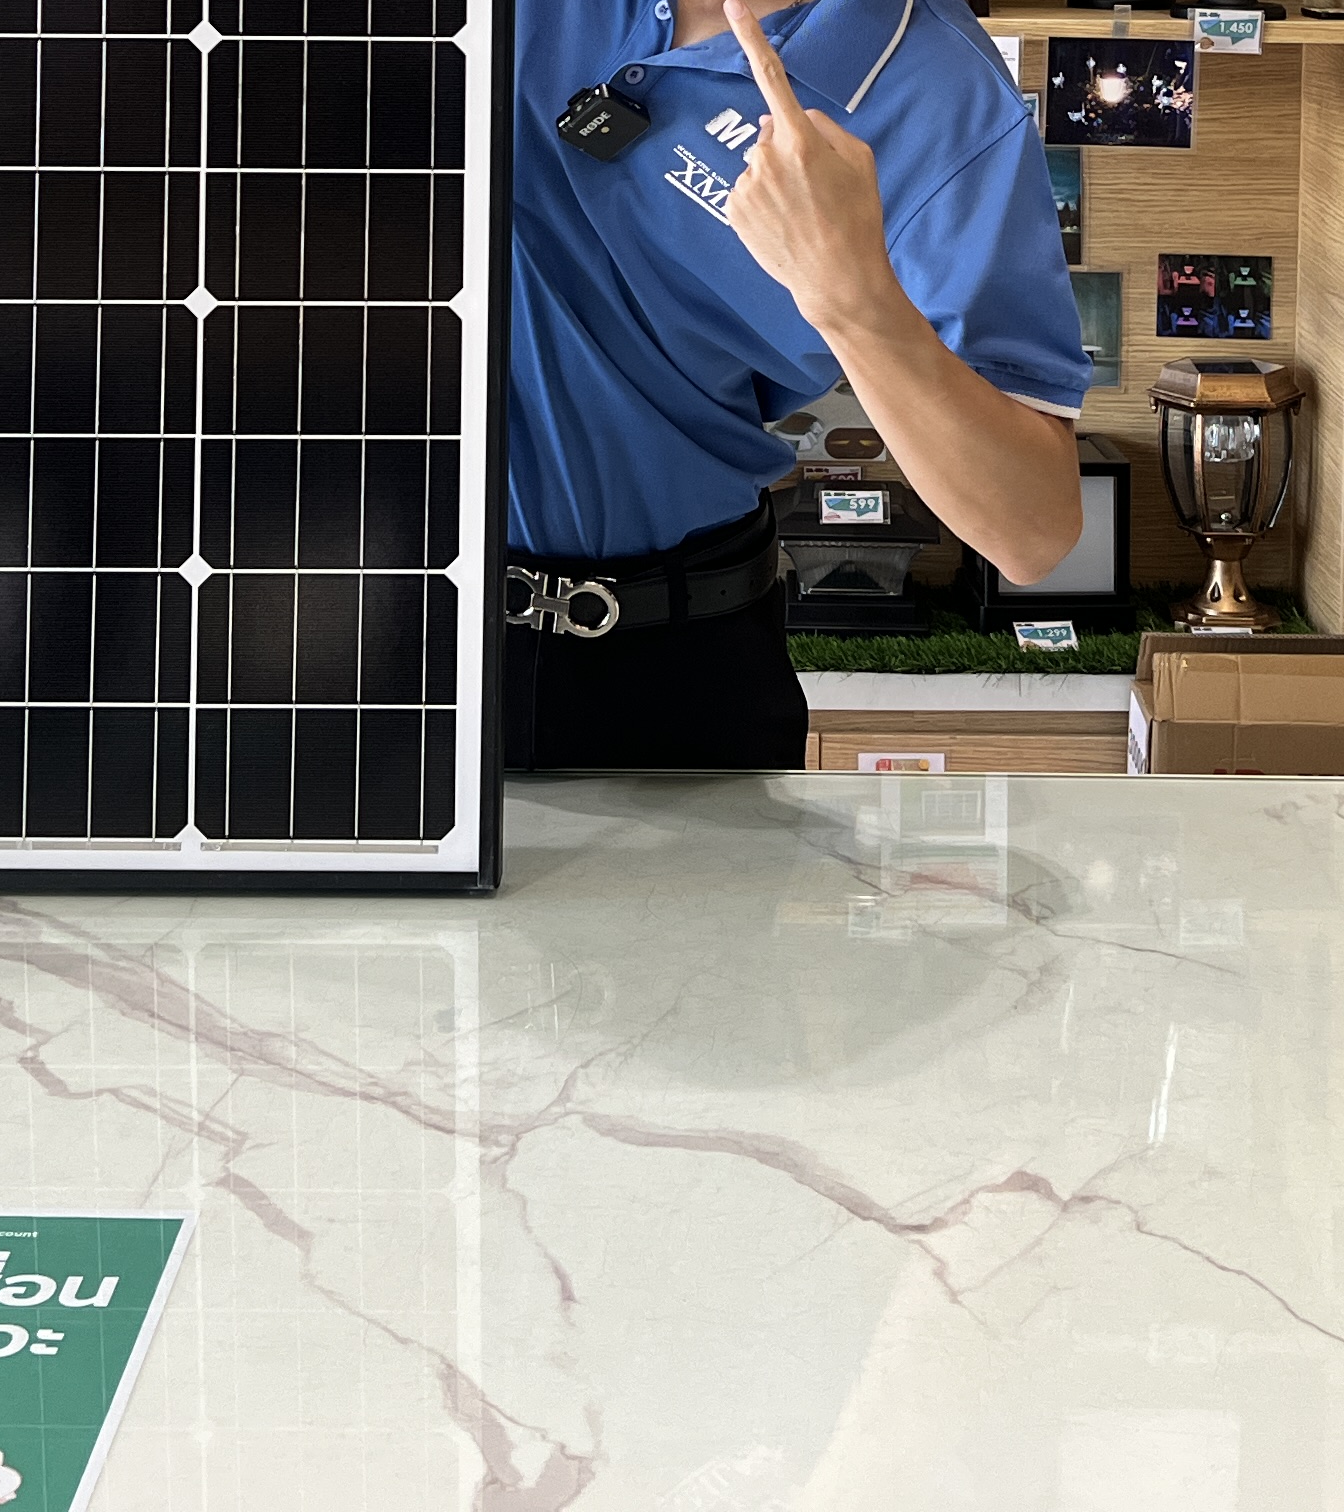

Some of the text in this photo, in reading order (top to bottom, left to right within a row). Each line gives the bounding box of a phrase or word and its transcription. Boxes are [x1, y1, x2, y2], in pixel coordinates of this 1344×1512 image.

[1219, 21, 1254, 35] 1,450
[849, 498, 876, 510] 599
[1036, 628, 1068, 638] 1,299
